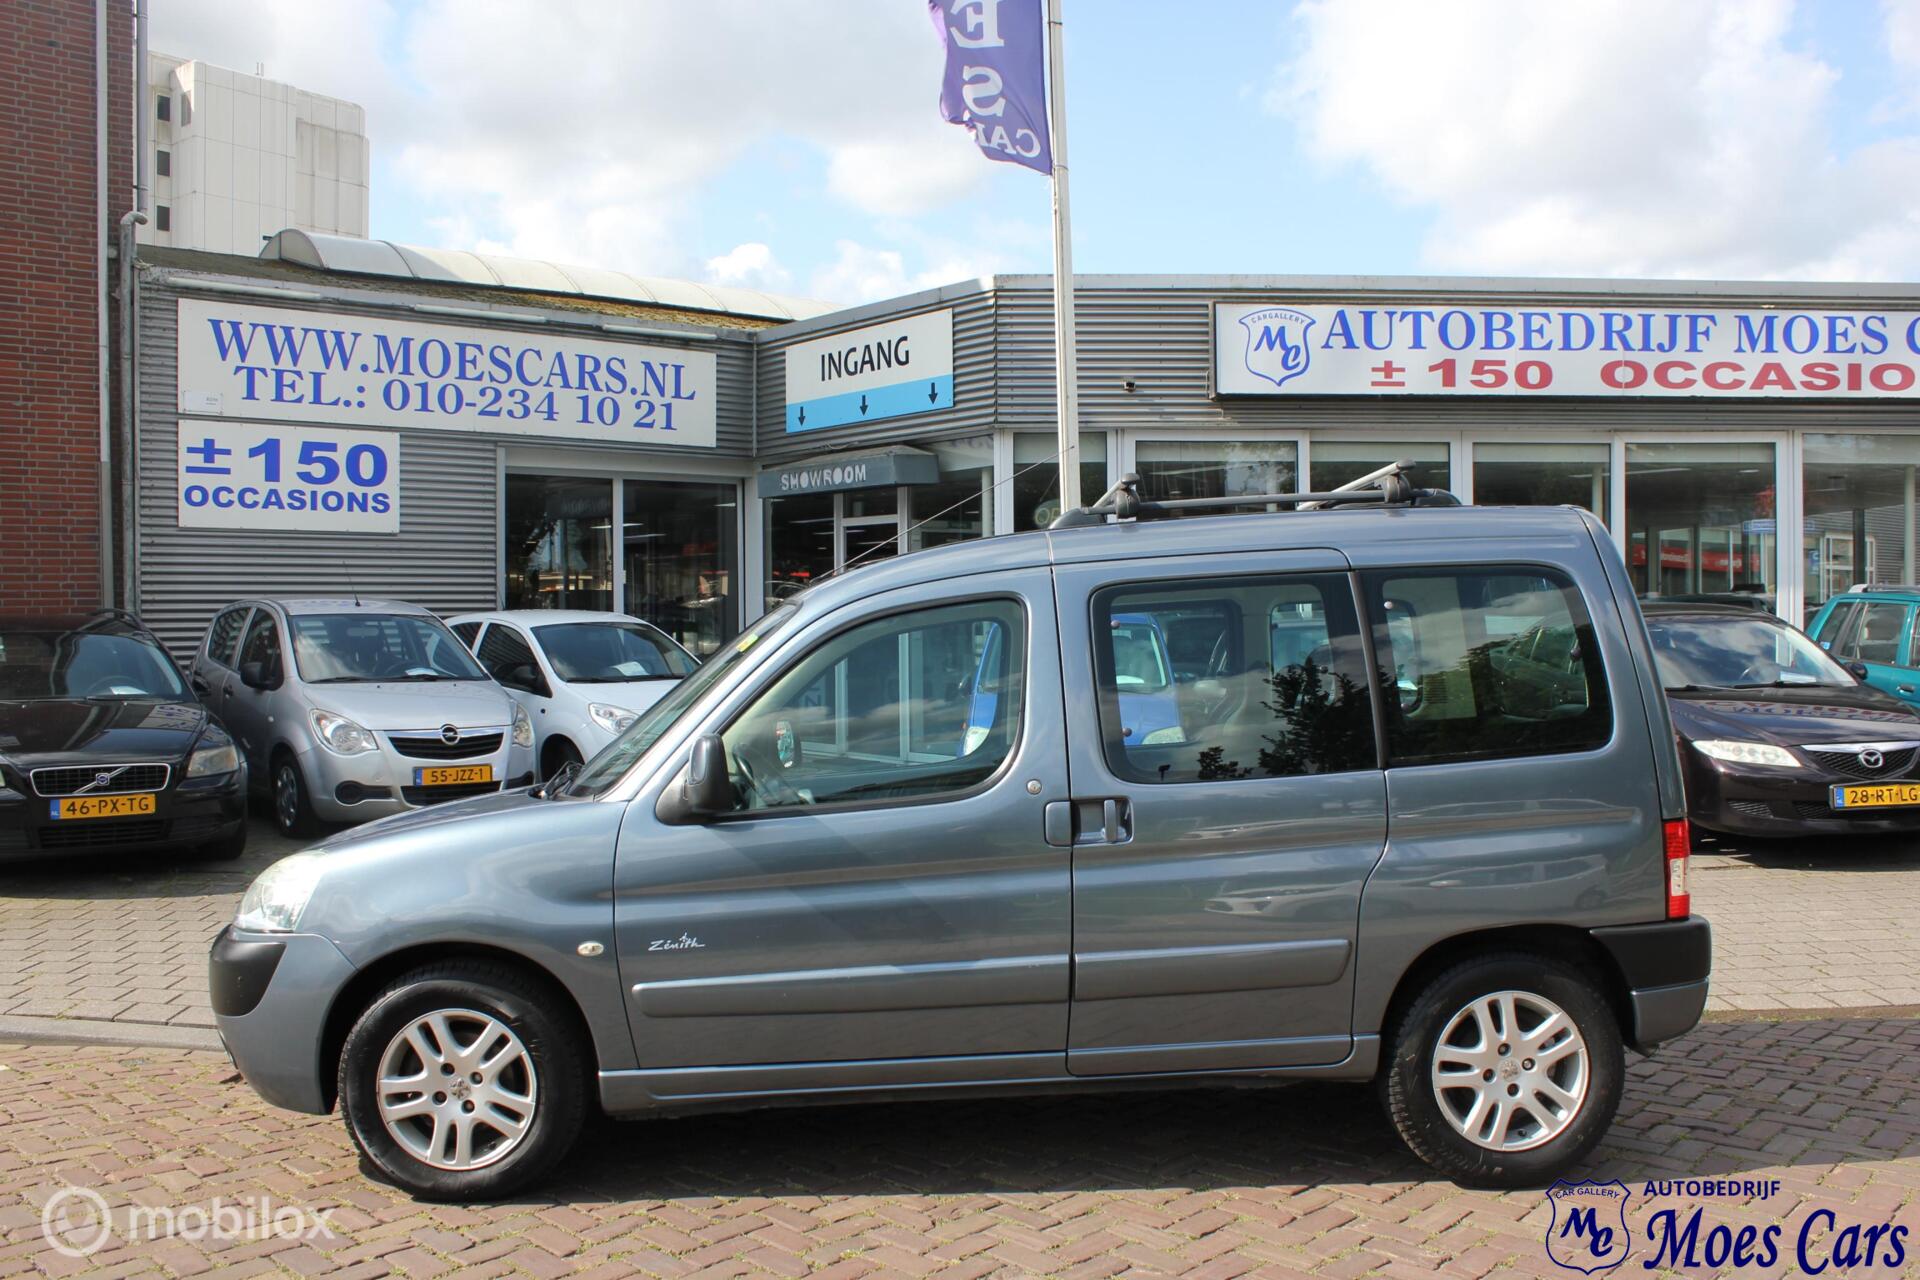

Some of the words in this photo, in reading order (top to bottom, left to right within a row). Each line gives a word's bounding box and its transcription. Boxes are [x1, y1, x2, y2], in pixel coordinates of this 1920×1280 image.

[1320, 308, 1719, 354] AUTOBEDRIJF
[1733, 313, 1890, 356] MOES
[207, 318, 696, 401] WWW.MOESCARS.NL
[820, 335, 910, 382] INGANG
[1428, 358, 1553, 390] 150
[1600, 360, 1916, 392] OCCASIO
[232, 364, 367, 409] TEL.:
[382, 378, 559, 422] 010-234
[575, 394, 621, 427] 10
[632, 399, 679, 433] 21
[780, 463, 867, 491] SHOWROOM
[183, 483, 391, 514] OCCASIONS
[430, 768, 484, 783] 55-JZZ-1
[66, 797, 150, 815] 46-PX-TG
[1849, 787, 1918, 804] 28-RT-LG
